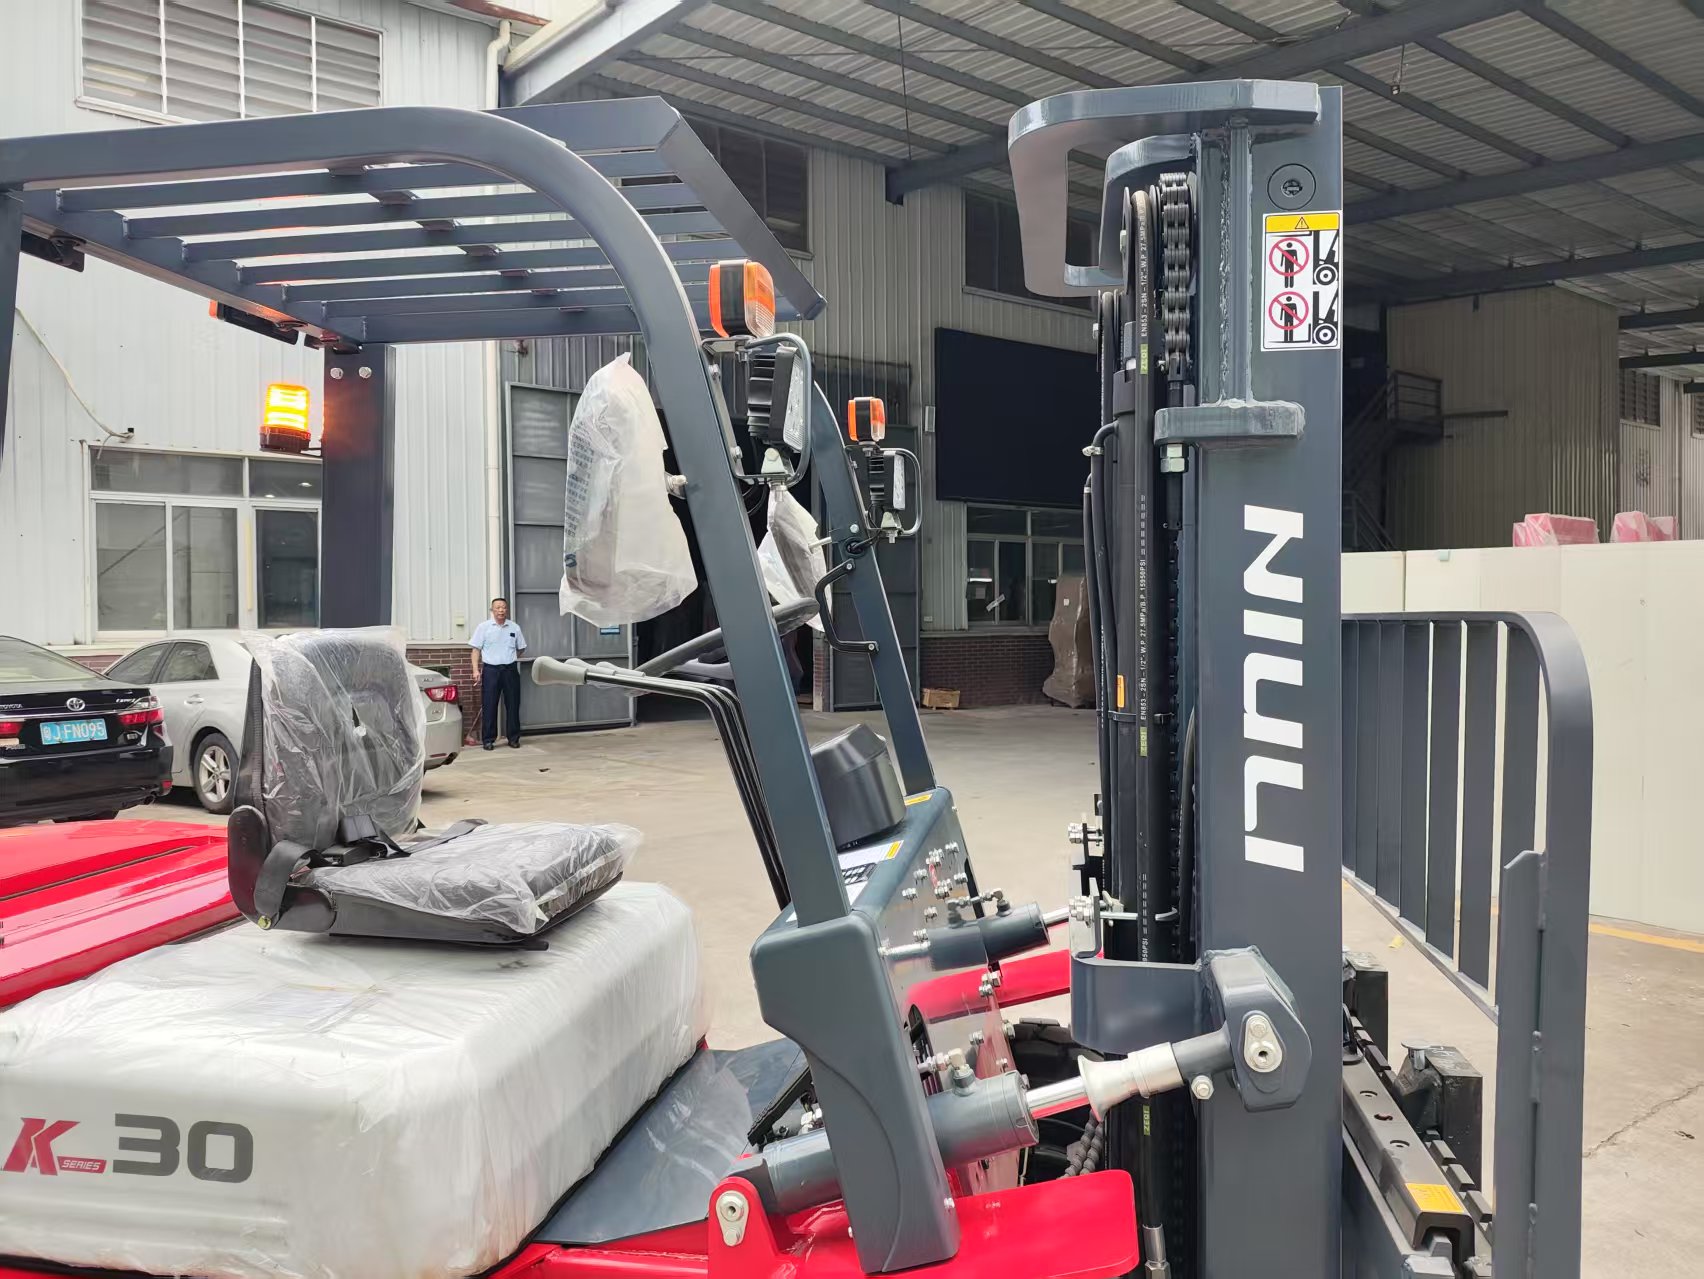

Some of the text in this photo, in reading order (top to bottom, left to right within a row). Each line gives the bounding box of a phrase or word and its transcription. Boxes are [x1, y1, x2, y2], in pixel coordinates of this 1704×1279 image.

[1244, 504, 1304, 872] NIULI
[3, 1113, 254, 1184] K SERIES 30
